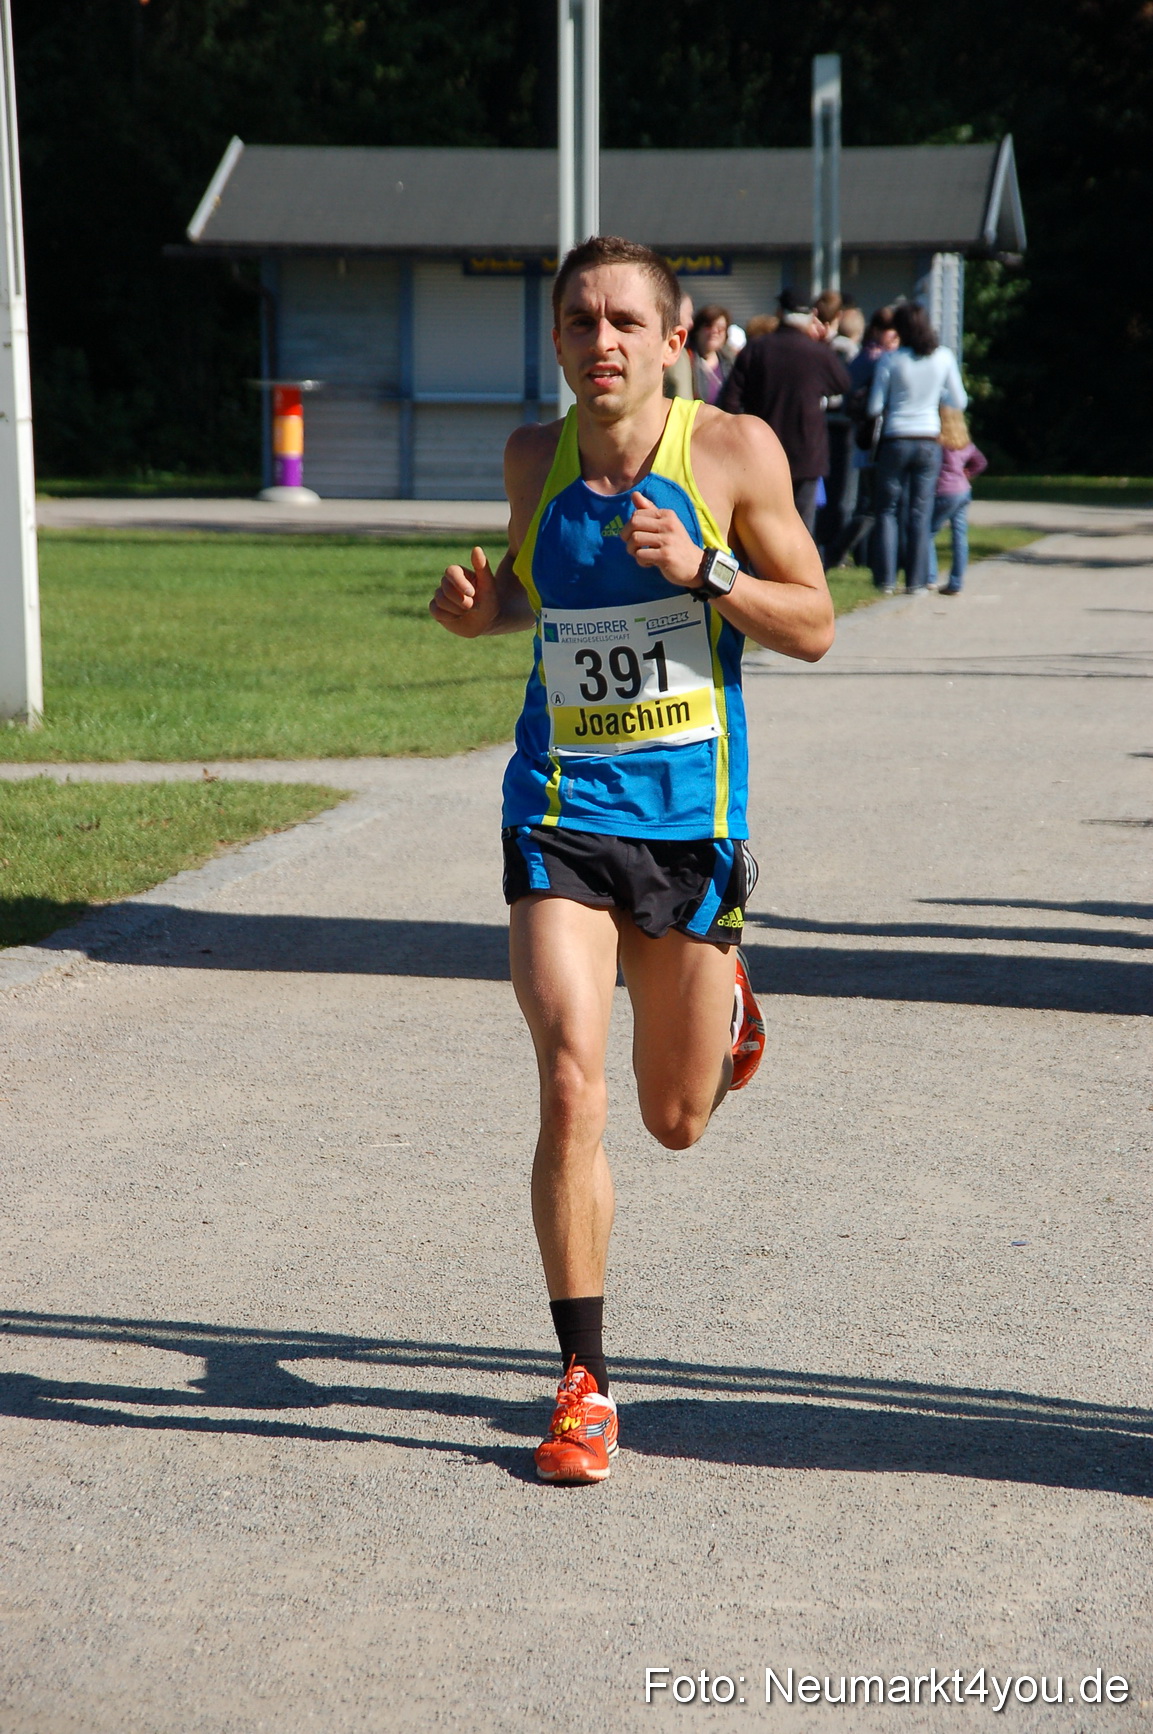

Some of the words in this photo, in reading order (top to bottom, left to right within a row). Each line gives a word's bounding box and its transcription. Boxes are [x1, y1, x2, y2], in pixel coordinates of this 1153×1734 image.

[559, 619, 629, 636] PFLEIDERER
[646, 611, 690, 629] BOCK
[561, 633, 631, 644] AKTIENGESELLSCHAFT
[575, 640, 669, 702] 391
[554, 694, 562, 704] A
[575, 700, 691, 737] Joachim
